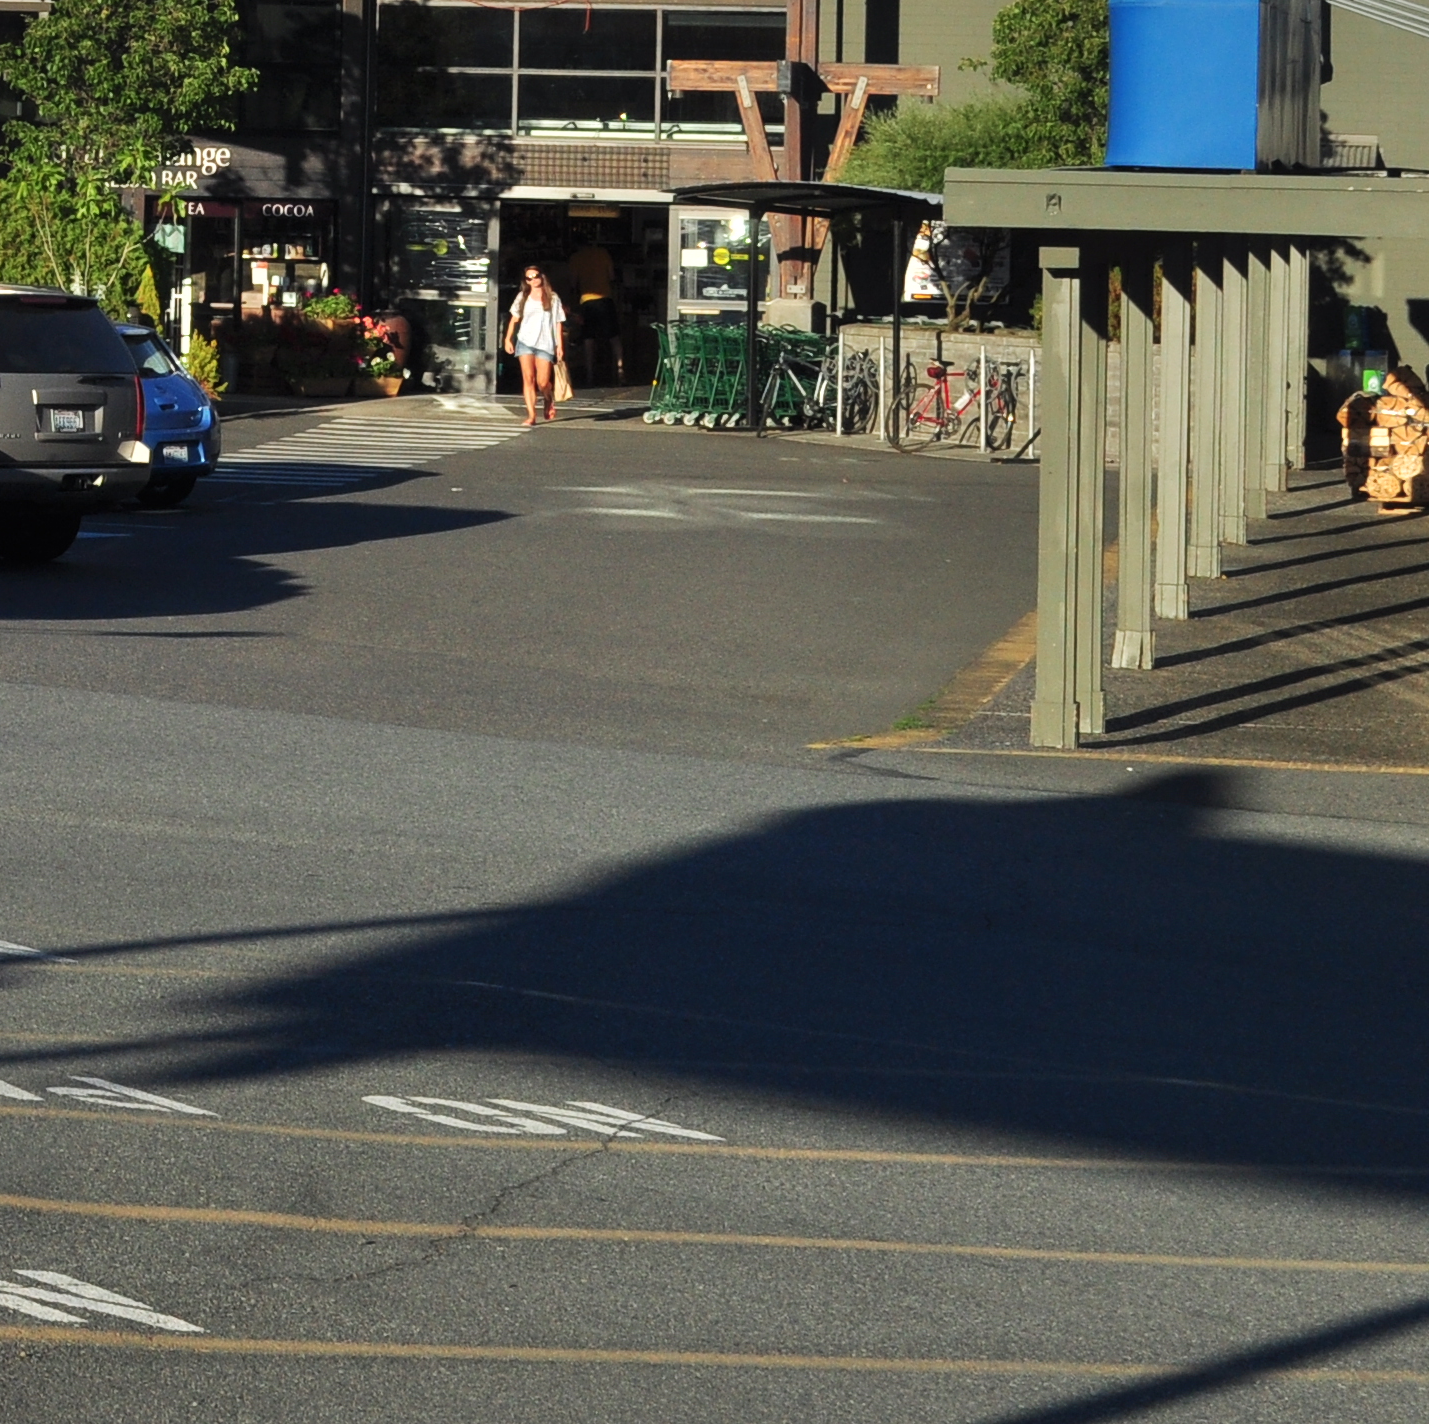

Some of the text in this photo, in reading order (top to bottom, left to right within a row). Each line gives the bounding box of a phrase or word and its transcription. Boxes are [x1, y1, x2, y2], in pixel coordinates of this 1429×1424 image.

[161, 170, 199, 189] BAR
[262, 203, 315, 217] COCOA
[361, 1094, 724, 1141] NO
